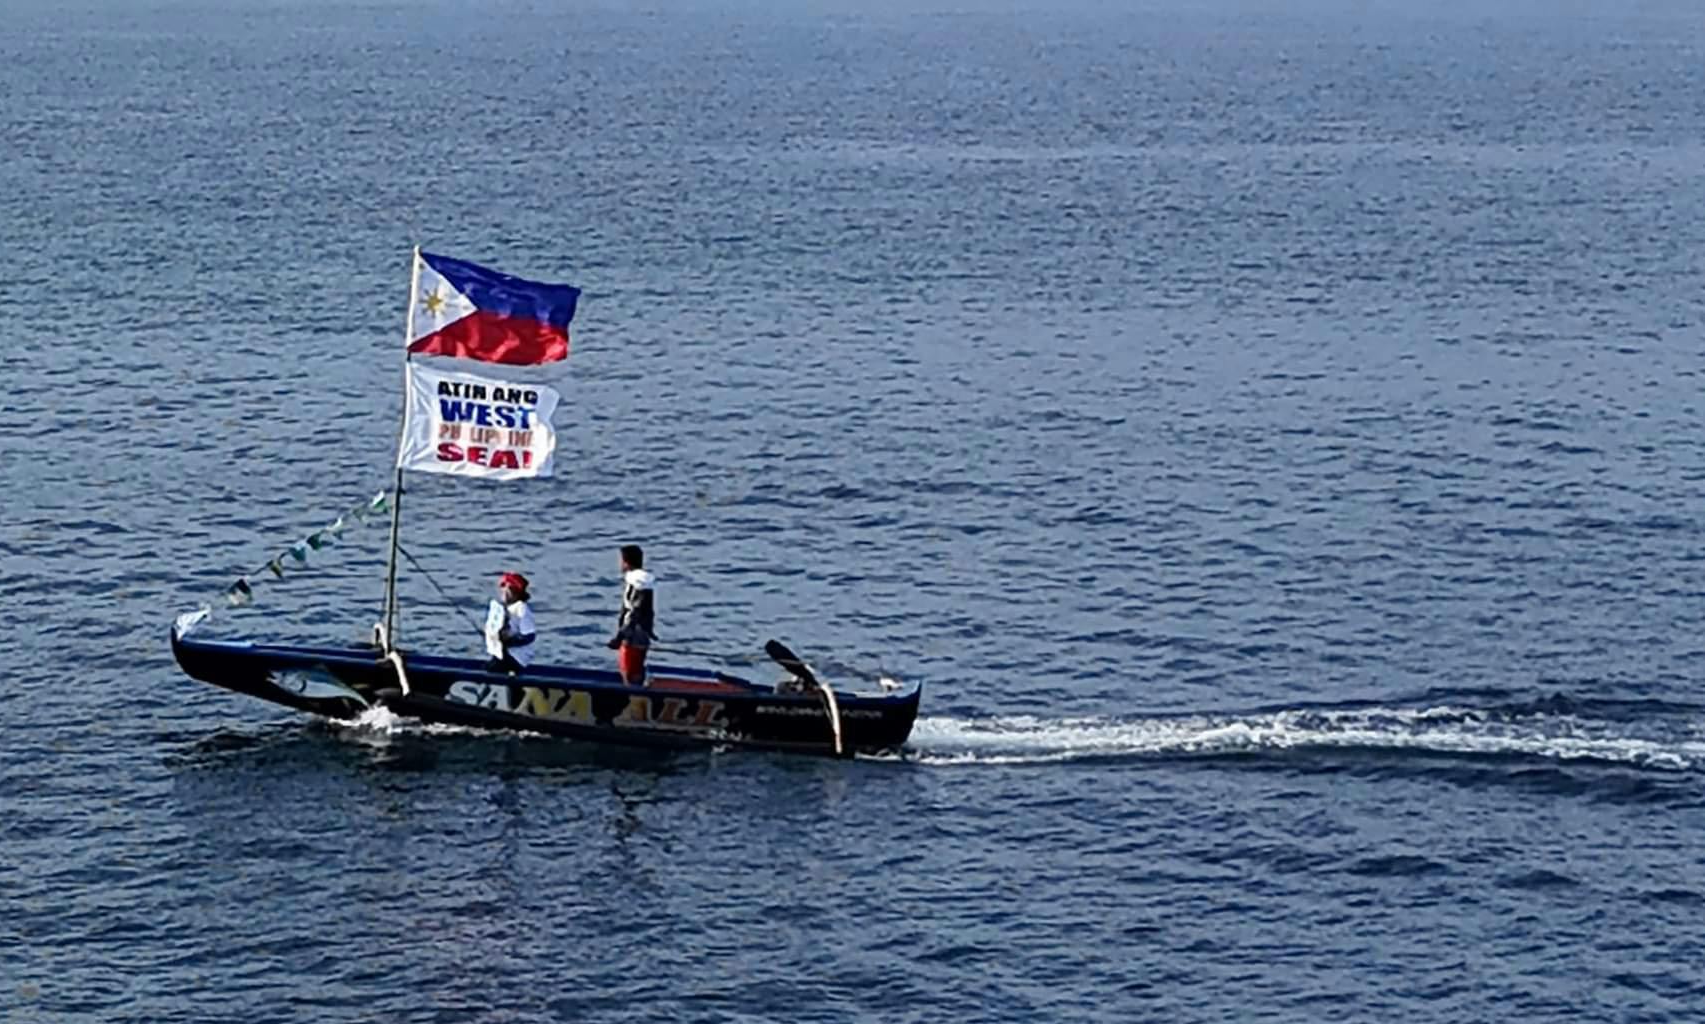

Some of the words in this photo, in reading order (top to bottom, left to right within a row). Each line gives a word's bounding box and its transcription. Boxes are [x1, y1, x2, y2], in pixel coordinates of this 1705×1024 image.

[438, 381, 487, 401] ATIN
[492, 387, 538, 405] ANG
[439, 399, 536, 429] WEST
[436, 443, 533, 470] SEA!
[445, 680, 596, 726] SANA
[612, 695, 730, 732] ALL
